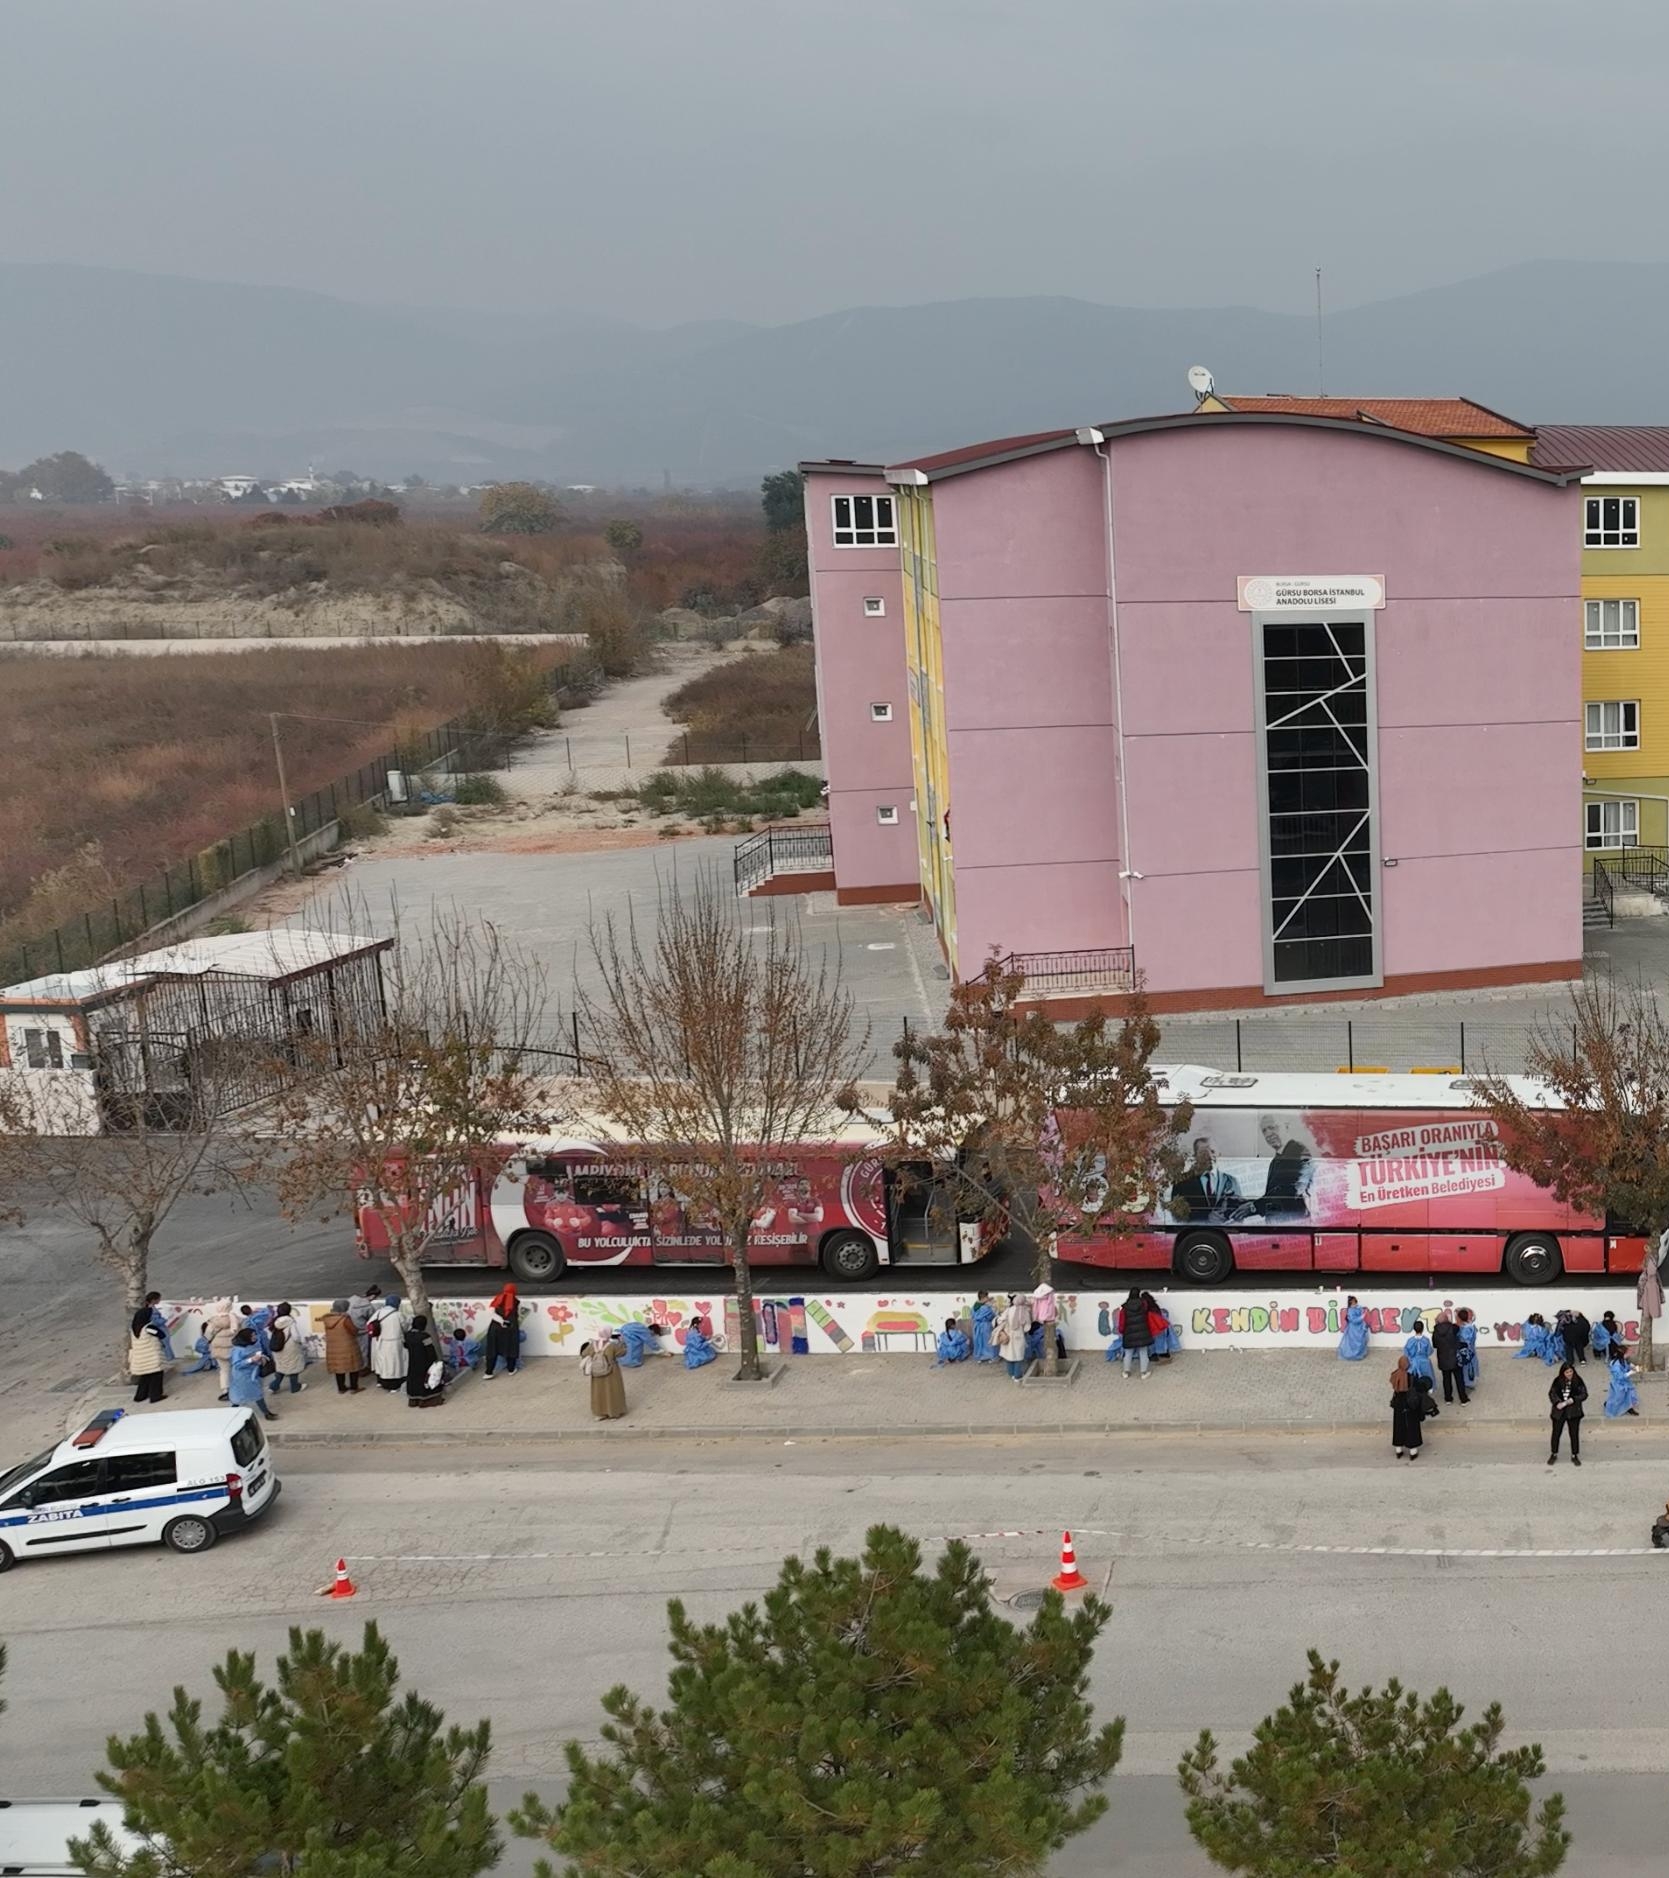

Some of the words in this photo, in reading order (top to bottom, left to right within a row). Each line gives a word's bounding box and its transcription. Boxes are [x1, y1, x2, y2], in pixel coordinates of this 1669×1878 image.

[1276, 588, 1302, 597] GÜRSU
[1303, 588, 1329, 596] BORSA
[1329, 587, 1365, 596] İSTANBUL
[1314, 597, 1336, 605] LİSESİ
[1362, 1130, 1416, 1155] BAŞARI
[1420, 1122, 1495, 1145] ORANIYLA
[1358, 1140, 1500, 1187] TÜRKİYE'NİN
[1360, 1191, 1375, 1203] En
[1377, 1184, 1429, 1201] Üretken
[1431, 1174, 1496, 1195] Belediyesi
[578, 1238, 591, 1249] BU
[1192, 1300, 1300, 1334] KENDİN
[27, 1509, 84, 1524] ZABITA
